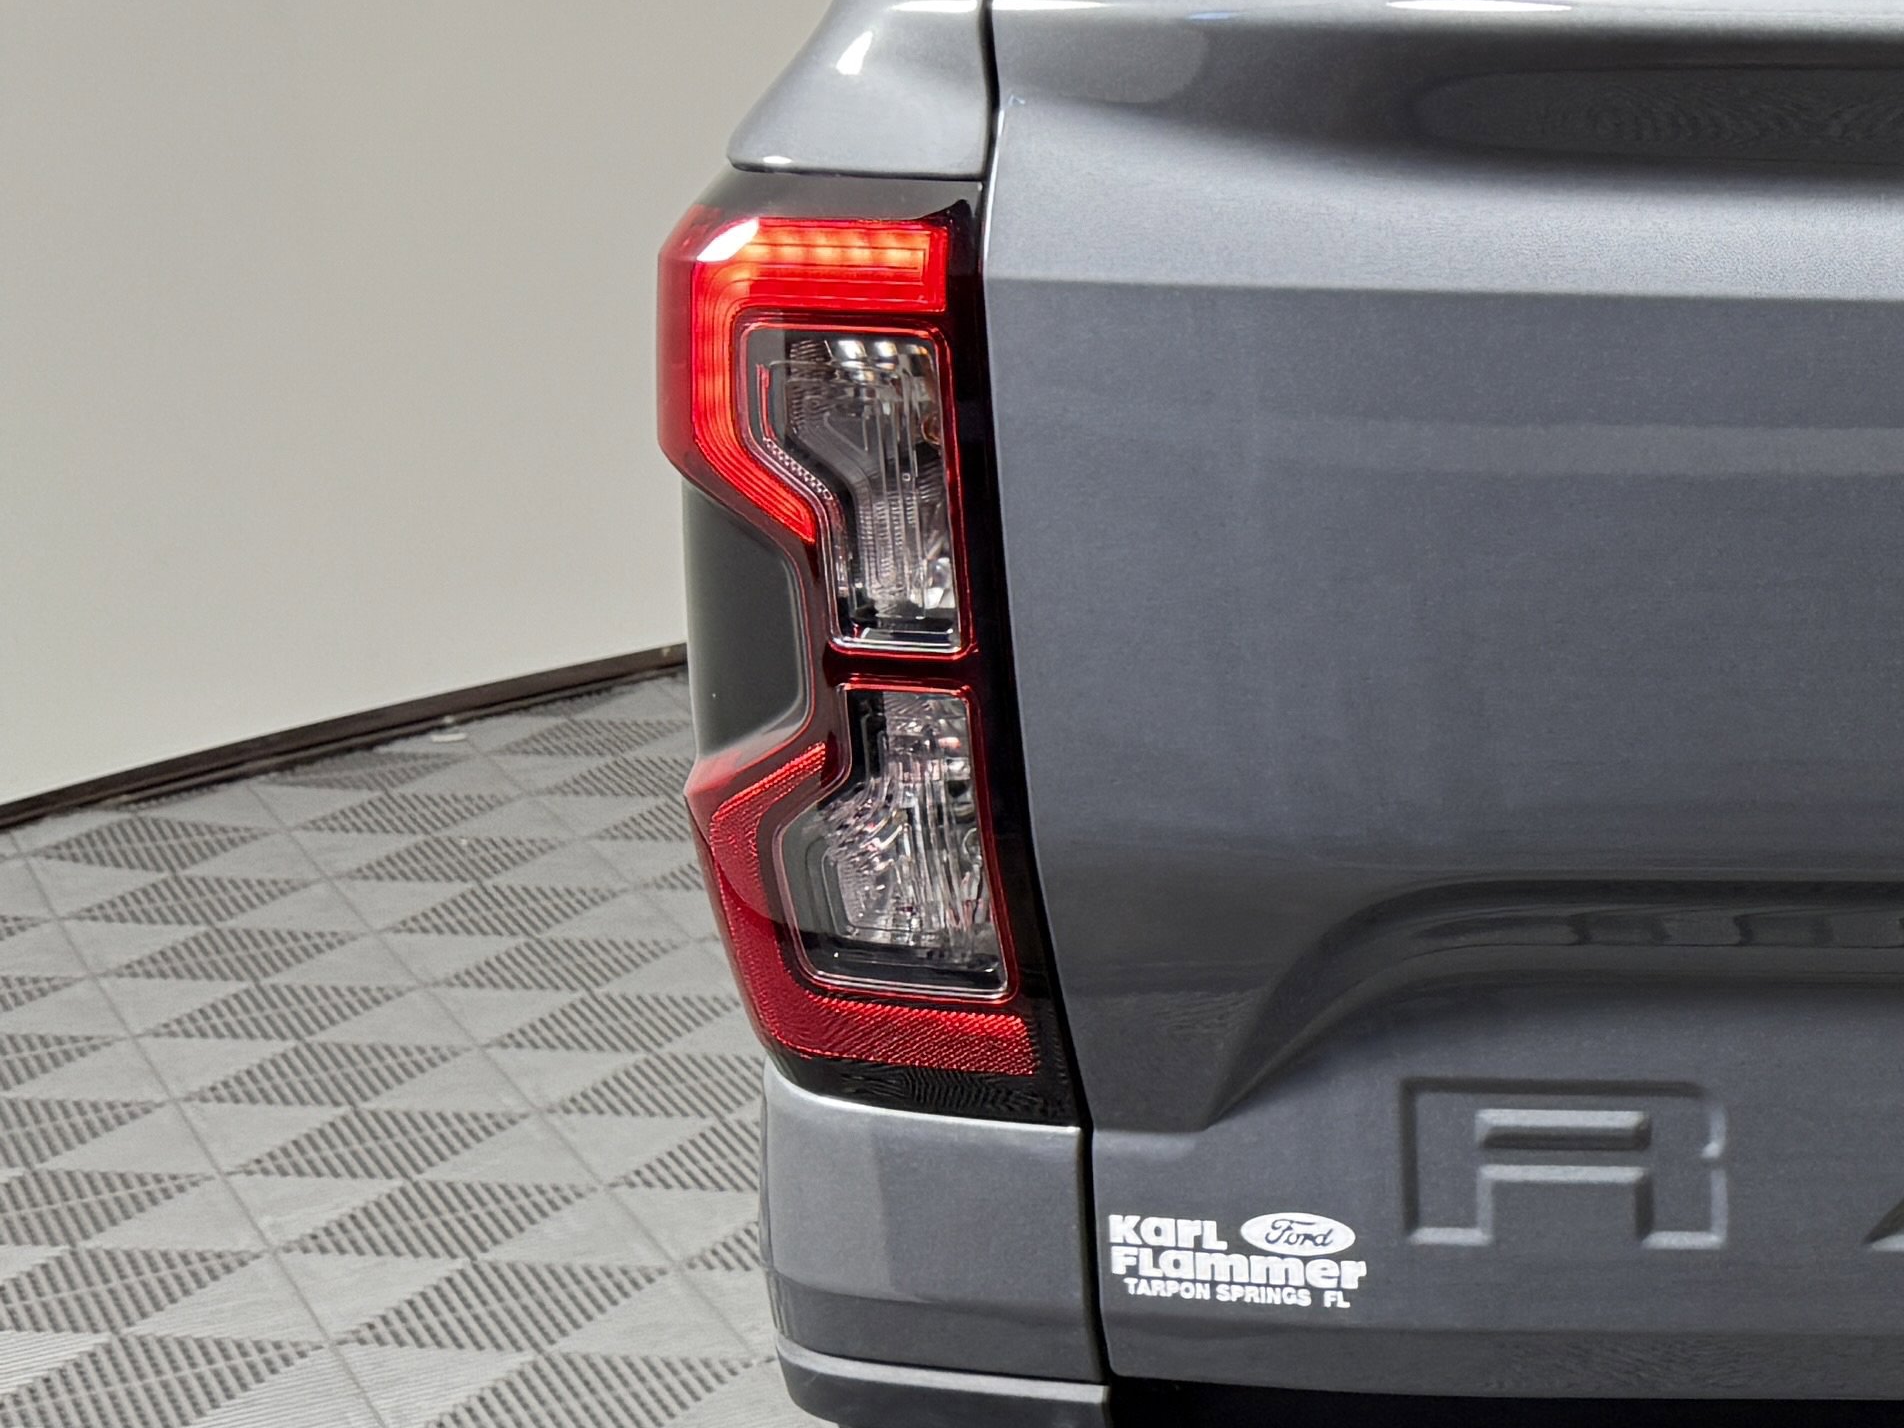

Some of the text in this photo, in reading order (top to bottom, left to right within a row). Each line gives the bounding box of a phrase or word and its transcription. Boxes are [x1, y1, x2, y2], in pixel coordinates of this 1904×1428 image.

[1265, 1219, 1334, 1247] Ford
[1124, 1278, 1350, 1308] TARPON SPRINGS FL
